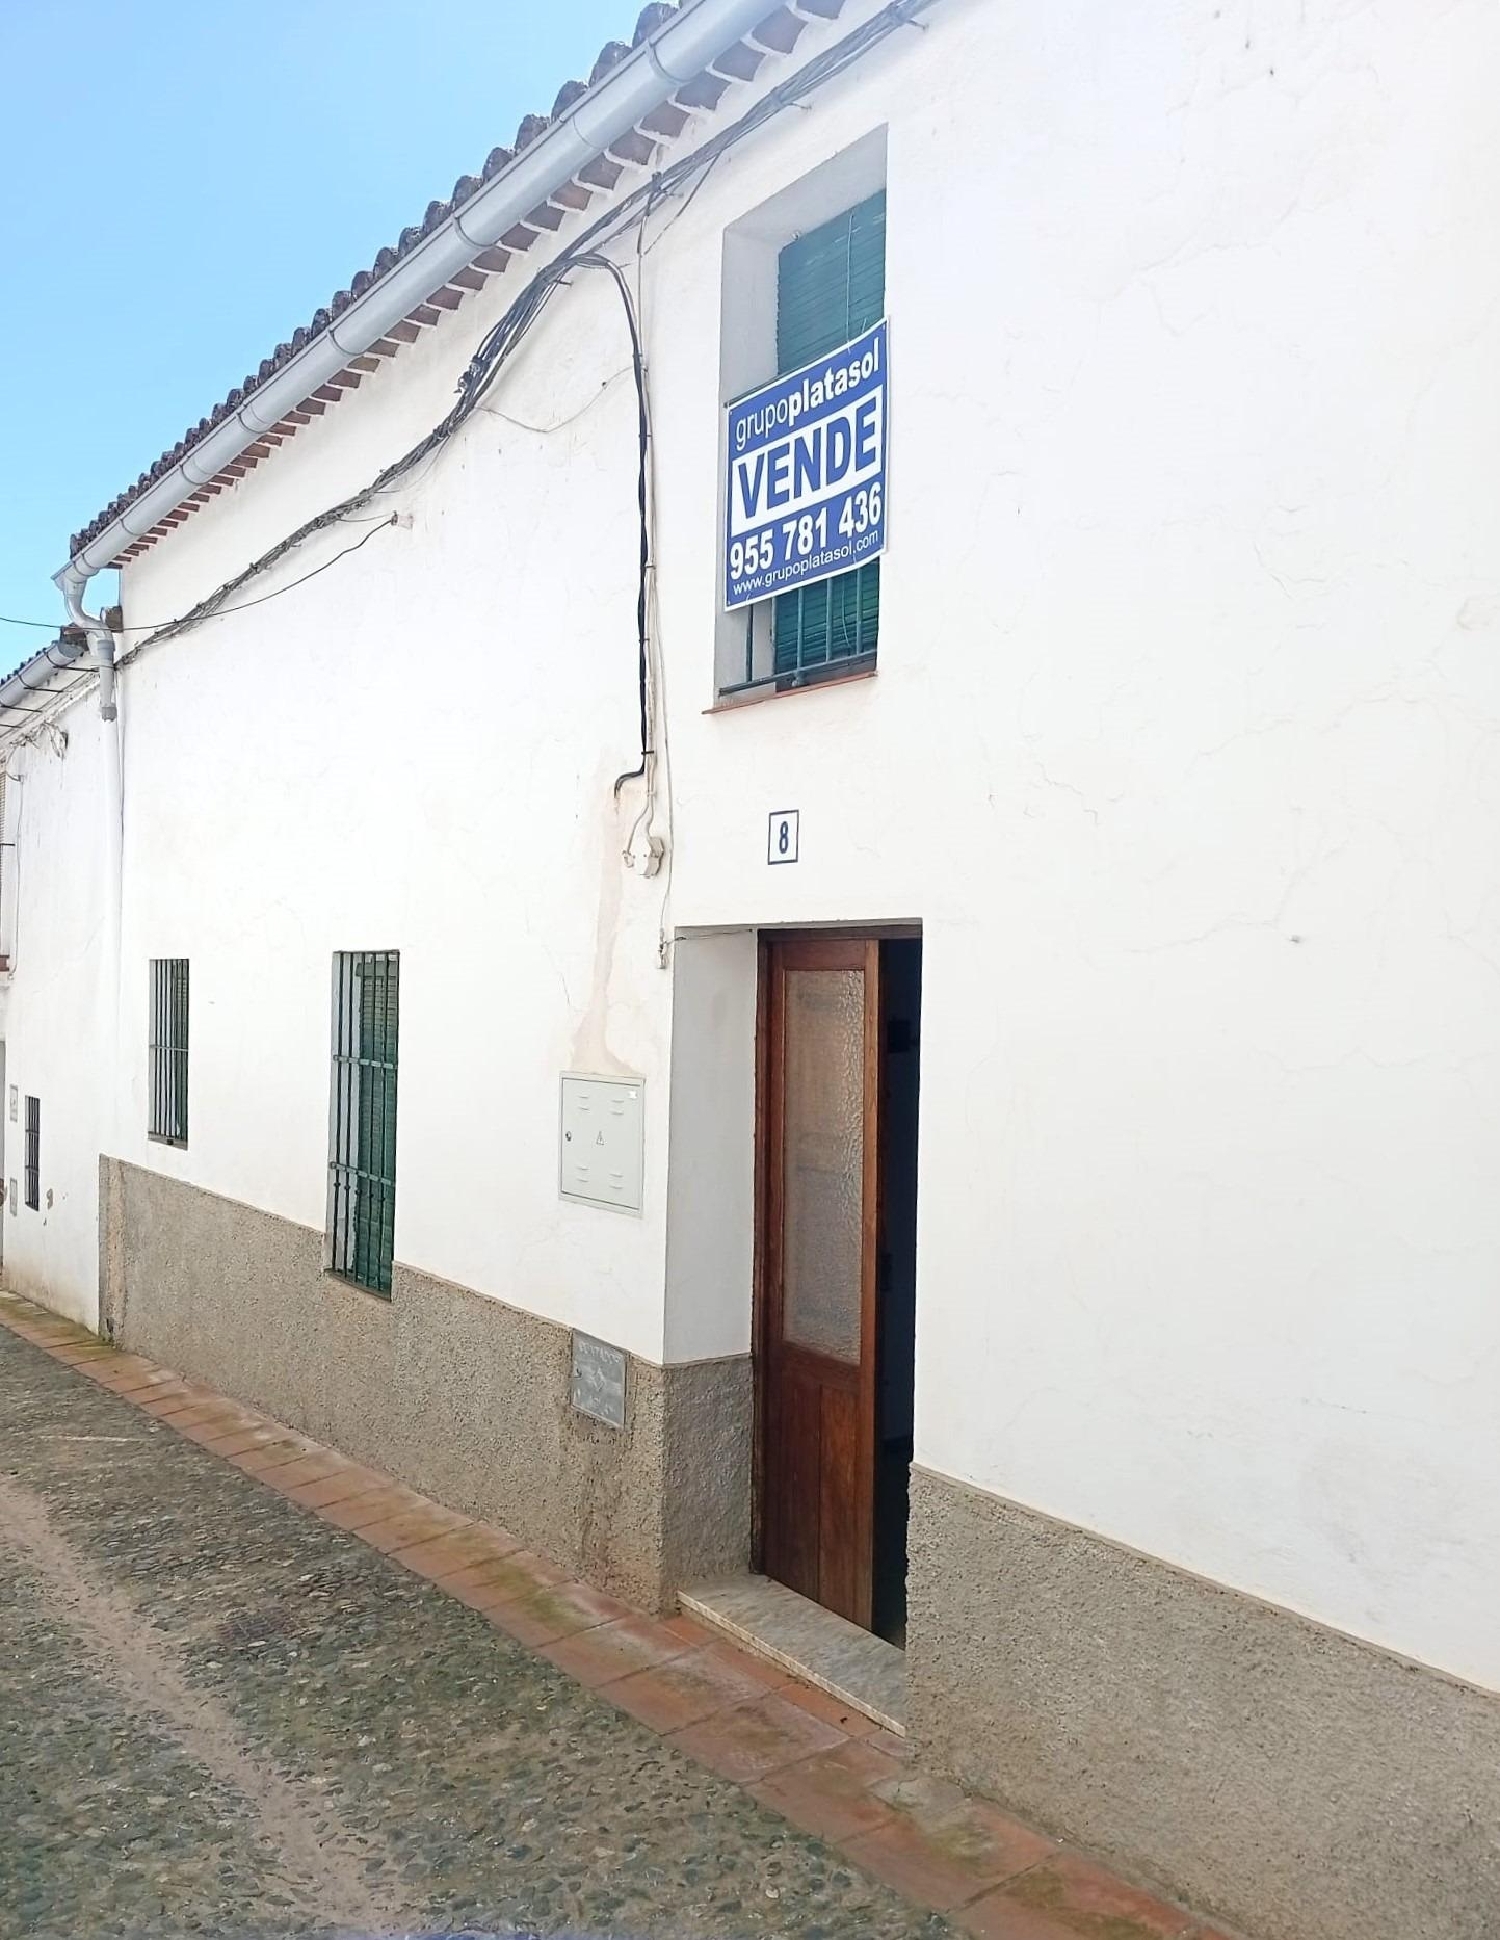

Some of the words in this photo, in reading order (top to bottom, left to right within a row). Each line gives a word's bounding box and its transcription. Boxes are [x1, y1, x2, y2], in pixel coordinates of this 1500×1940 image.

[736, 337, 879, 451] grupoplatasol
[738, 395, 878, 519] VENDE
[730, 529, 774, 580] 955
[782, 506, 828, 561] 781
[838, 481, 881, 538] 436
[733, 530, 878, 595] www.grupoplatasol.com
[779, 820, 789, 855] 8
